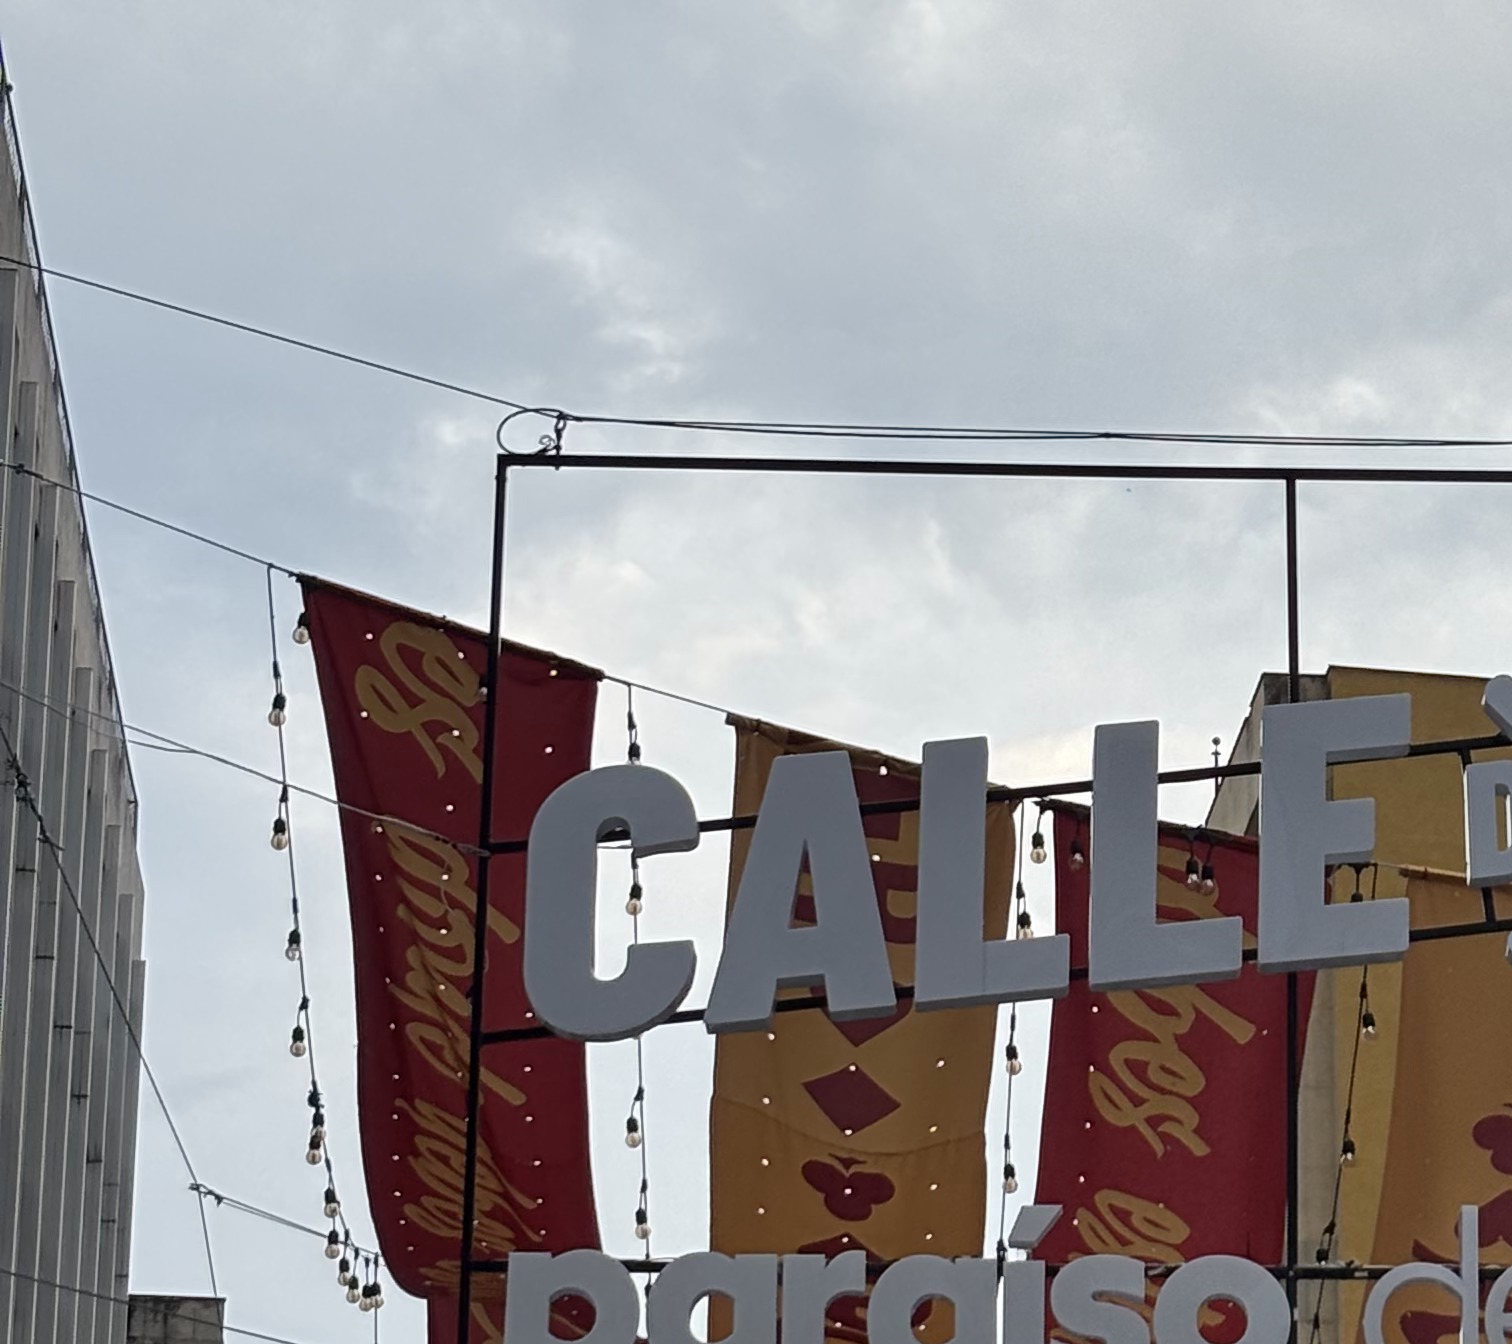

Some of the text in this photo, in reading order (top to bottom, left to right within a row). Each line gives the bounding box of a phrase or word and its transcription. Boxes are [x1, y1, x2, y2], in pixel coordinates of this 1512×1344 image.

[354, 620, 484, 783] es
[386, 820, 528, 1106] donde
[522, 692, 1412, 1043] CALLE
